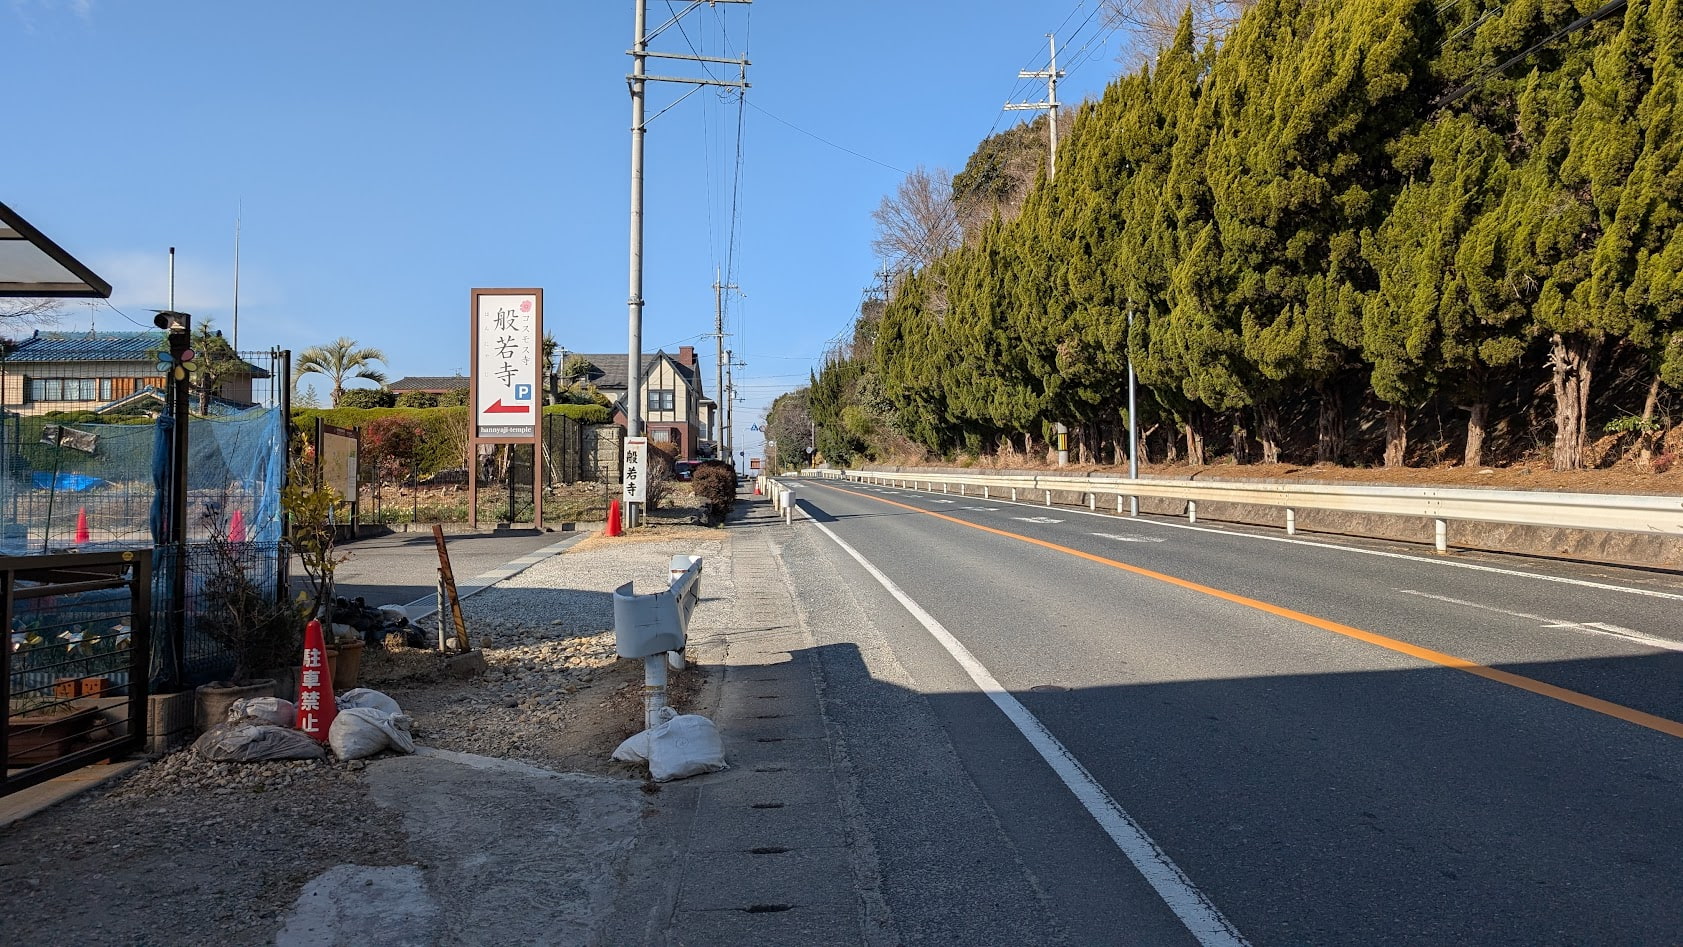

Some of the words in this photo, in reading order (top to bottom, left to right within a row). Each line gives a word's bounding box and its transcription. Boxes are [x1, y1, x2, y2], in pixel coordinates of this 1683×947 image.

[493, 307, 519, 388] 般若寺
[522, 315, 531, 366] コスモス寺
[626, 450, 638, 497] 般若寺
[301, 648, 321, 732] 駐車禁止
